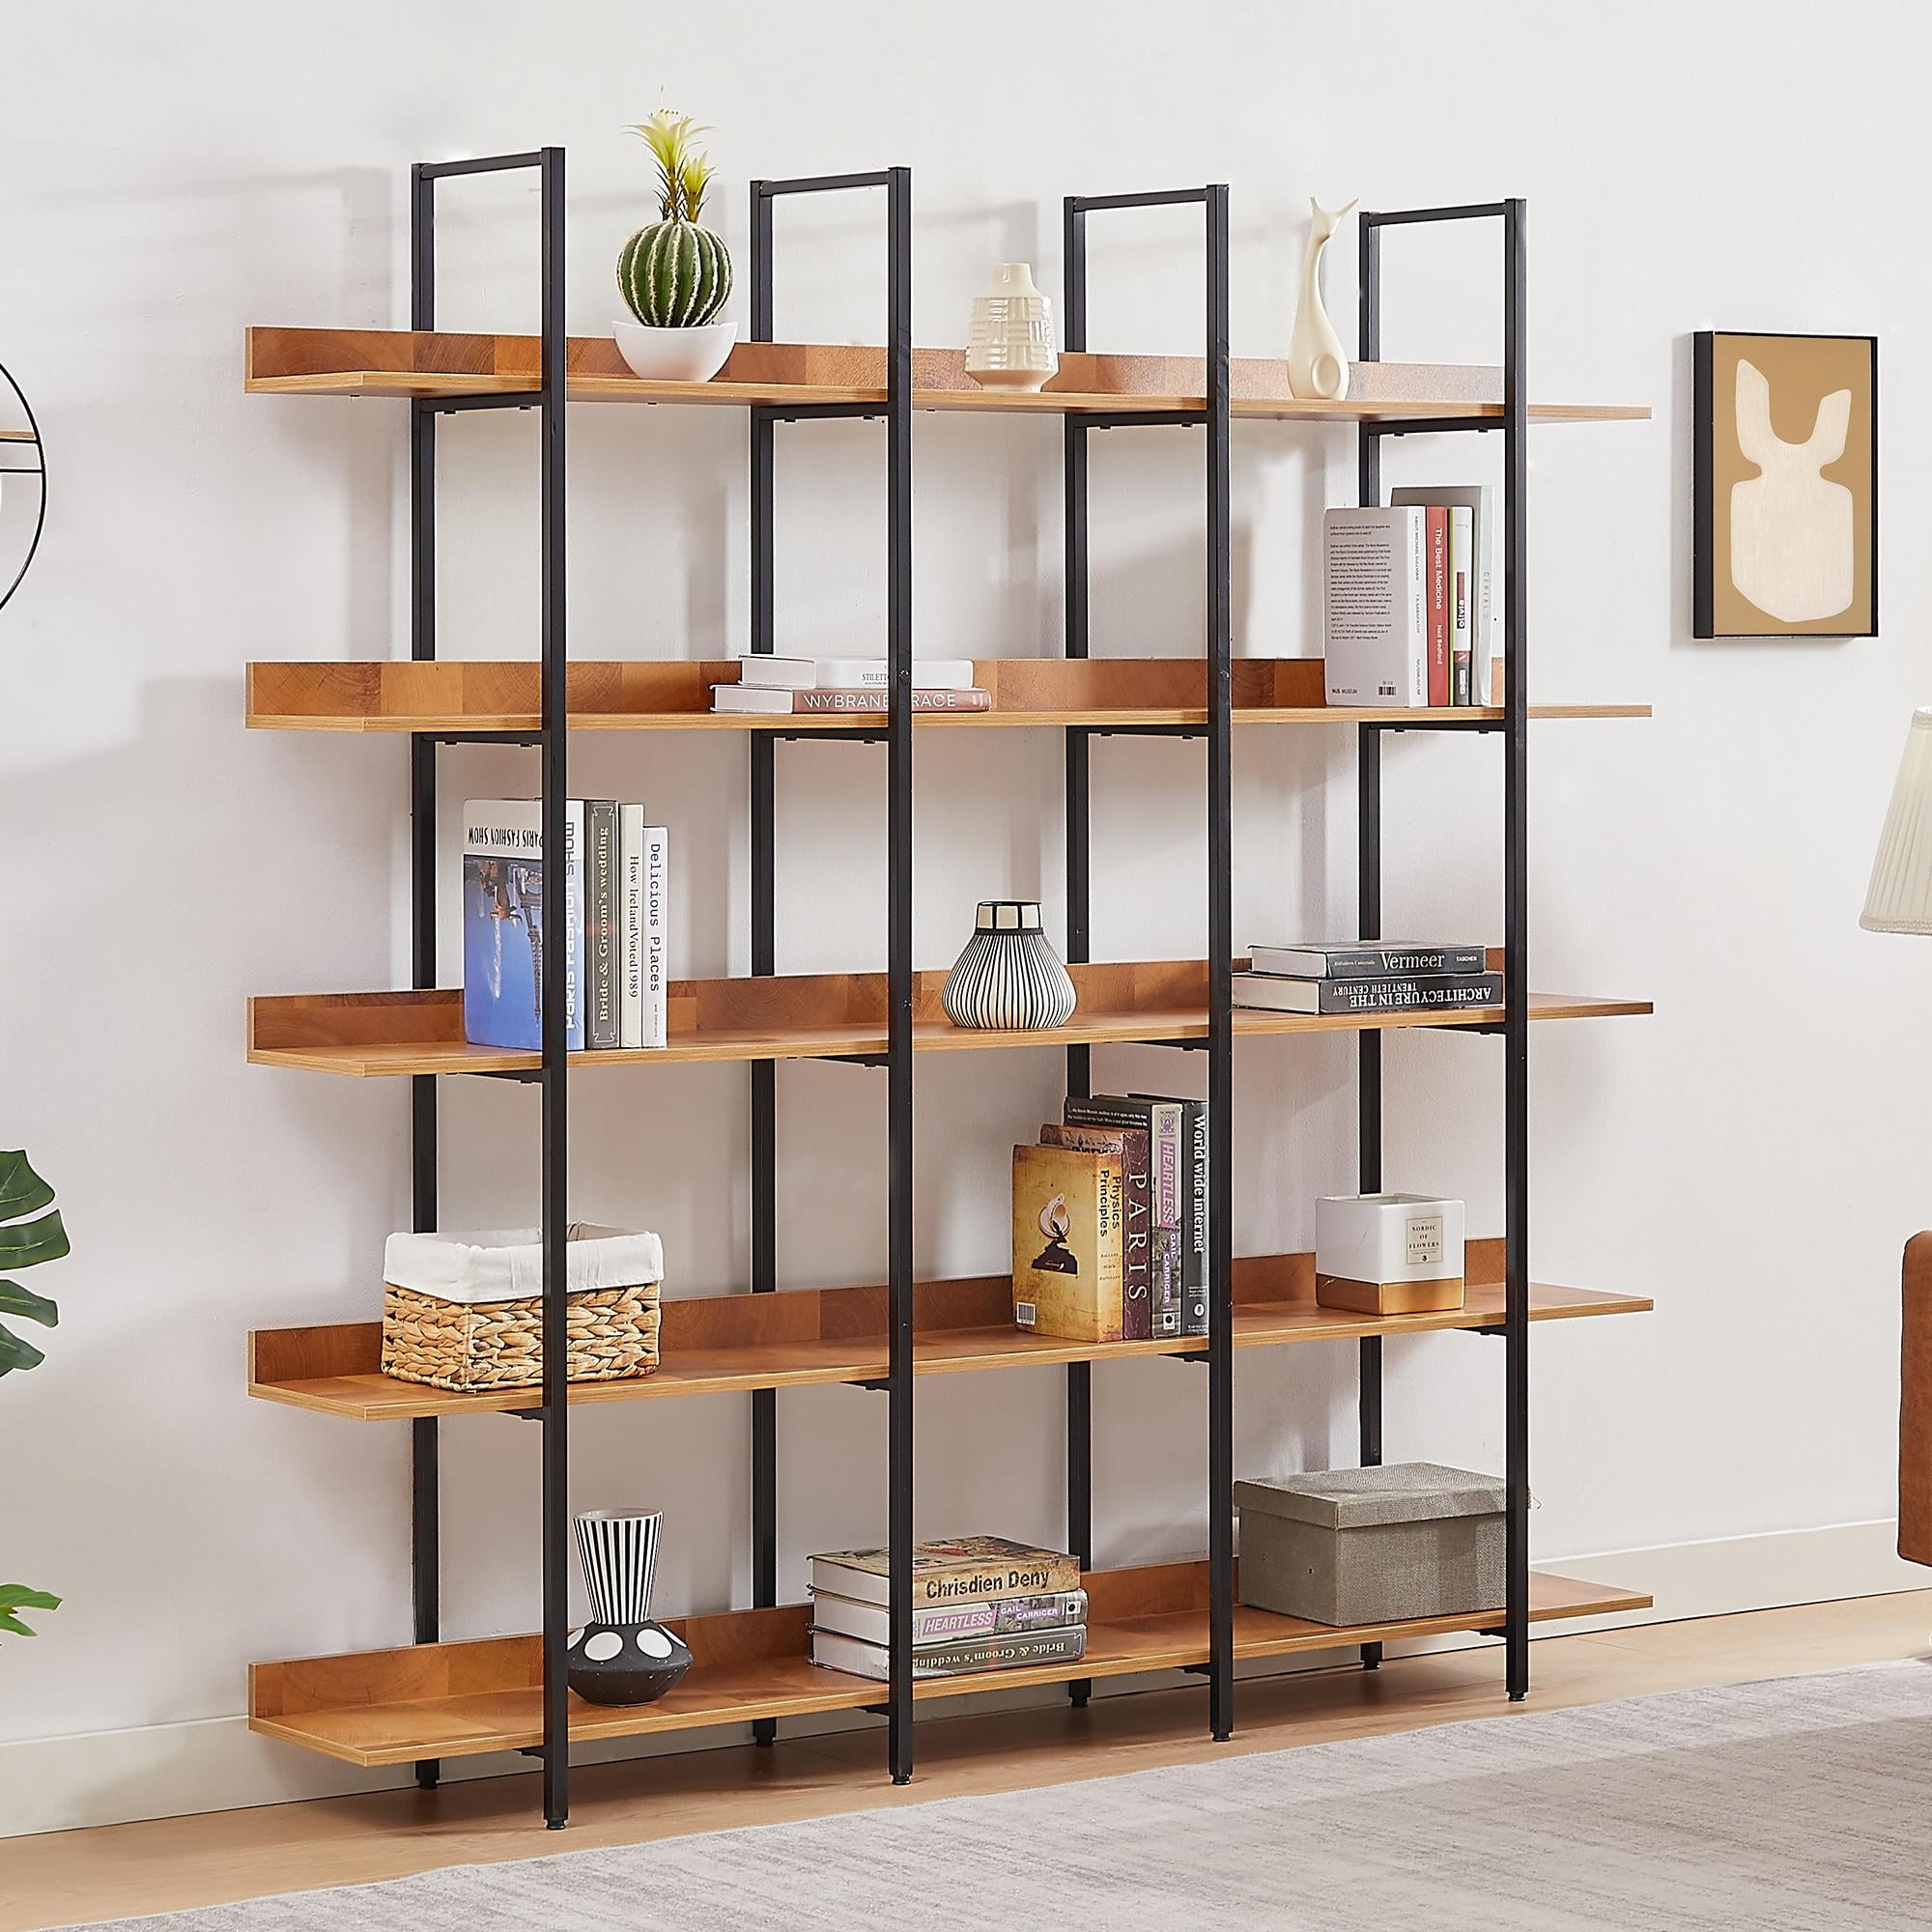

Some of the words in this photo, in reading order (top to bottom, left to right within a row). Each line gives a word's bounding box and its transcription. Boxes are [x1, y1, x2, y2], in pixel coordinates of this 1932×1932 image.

[1435, 527, 1443, 545] The
[1435, 548, 1443, 568] Best
[1435, 570, 1443, 610] Medicine
[862, 672, 887, 681] STILETT
[804, 694, 889, 709] WYBRANE
[911, 694, 956, 708] RACE
[469, 827, 489, 845] SHOW
[598, 827, 610, 888] wedding
[629, 856, 639, 884] How
[649, 843, 661, 926] Delicious
[598, 892, 609, 958] Groom's
[599, 962, 609, 977] &
[650, 936, 661, 992] Places
[1380, 952, 1445, 970] Vermeer
[599, 981, 609, 1021] Bride
[1332, 985, 1369, 997] CENTURY
[1350, 994, 1377, 1007] THE
[1194, 1114, 1207, 1158] World
[1162, 1143, 1175, 1224] HEARTLESS
[1193, 1160, 1206, 1195] wide
[1098, 1170, 1110, 1237] Principles
[1111, 1176, 1122, 1230] Physics
[1128, 1172, 1147, 1300] PARIS
[1193, 1196, 1206, 1253] internet
[926, 1574, 1004, 1599] Chrisdien
[1008, 1571, 1050, 1591] Deny
[924, 1611, 993, 1633] HEARTLESS
[1001, 1605, 1022, 1615] GAIL
[964, 1648, 1016, 1663] Groom's
[1018, 1646, 1030, 1657] &
[1033, 1641, 1065, 1653] Bride
[913, 1656, 961, 1669] wedding
